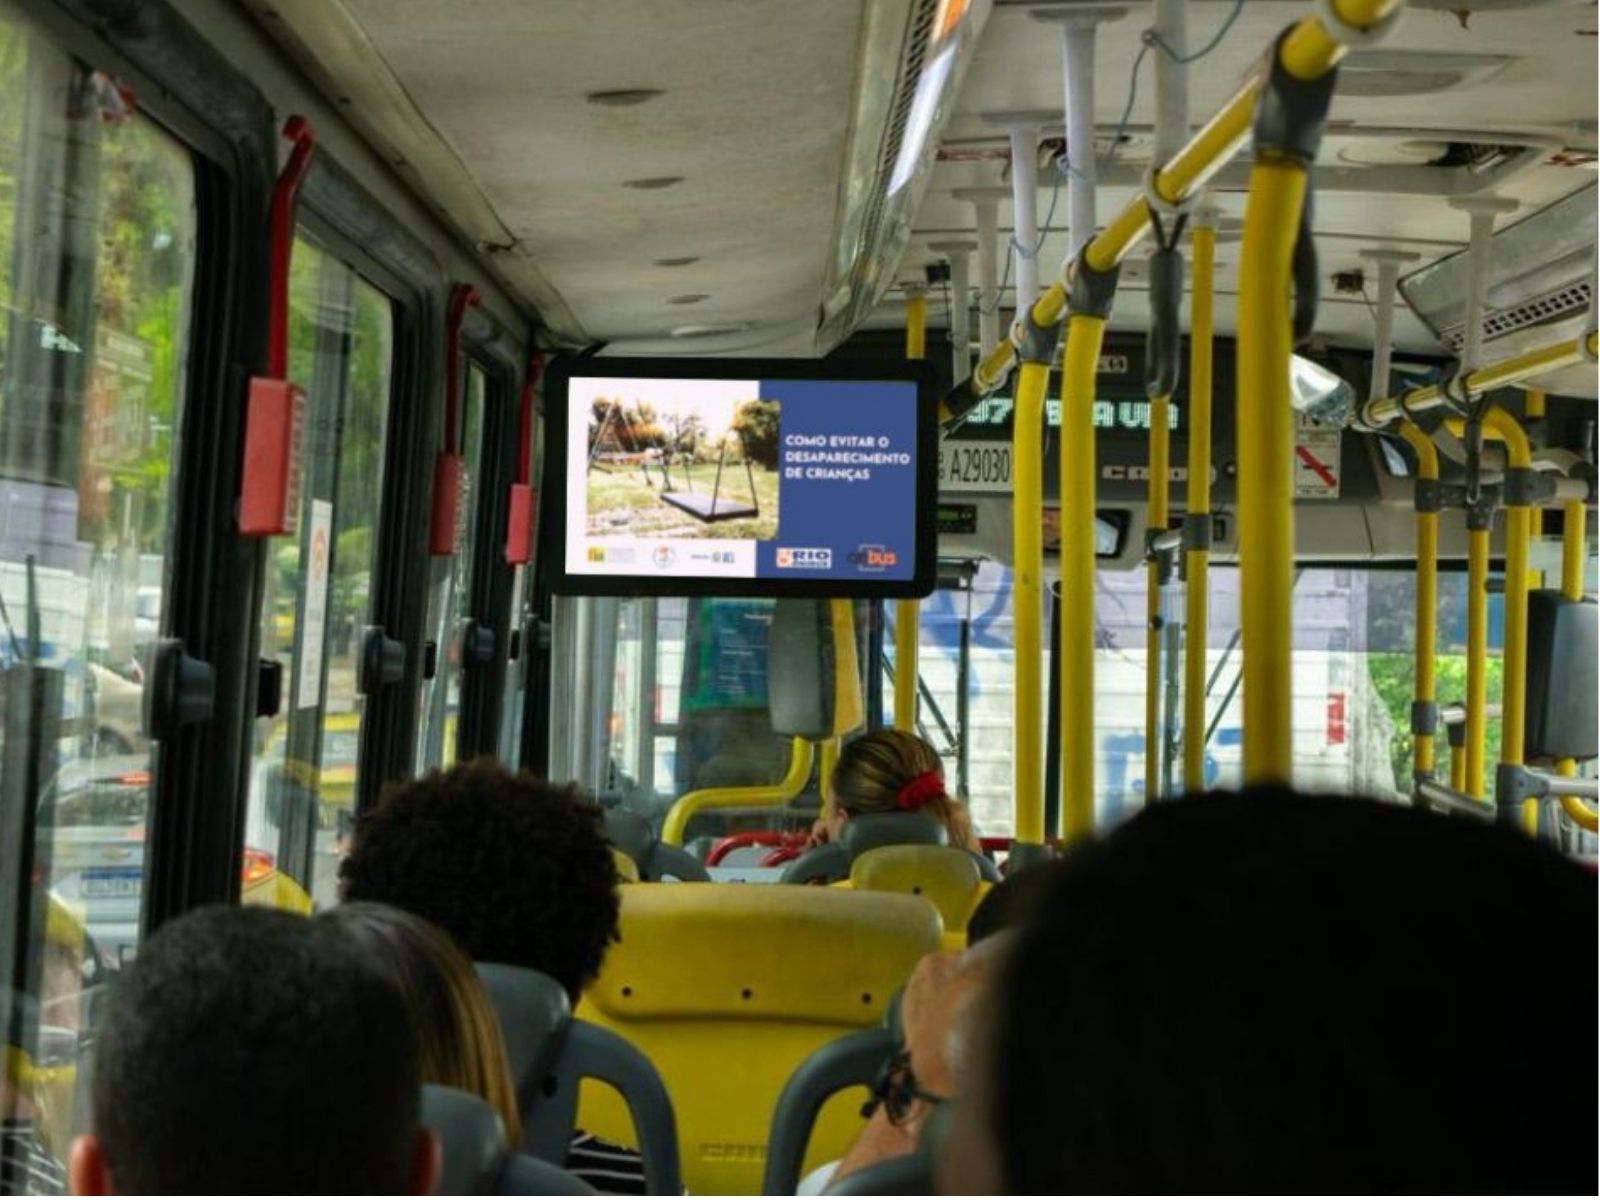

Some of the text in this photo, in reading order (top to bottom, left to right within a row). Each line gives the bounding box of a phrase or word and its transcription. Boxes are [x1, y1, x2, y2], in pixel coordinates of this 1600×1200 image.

[785, 434, 890, 448] COMO EVITAR O
[785, 451, 910, 465] DESAPARECIMENTO
[950, 448, 1010, 482] A29030
[785, 467, 871, 482] DE CRIANÇAS
